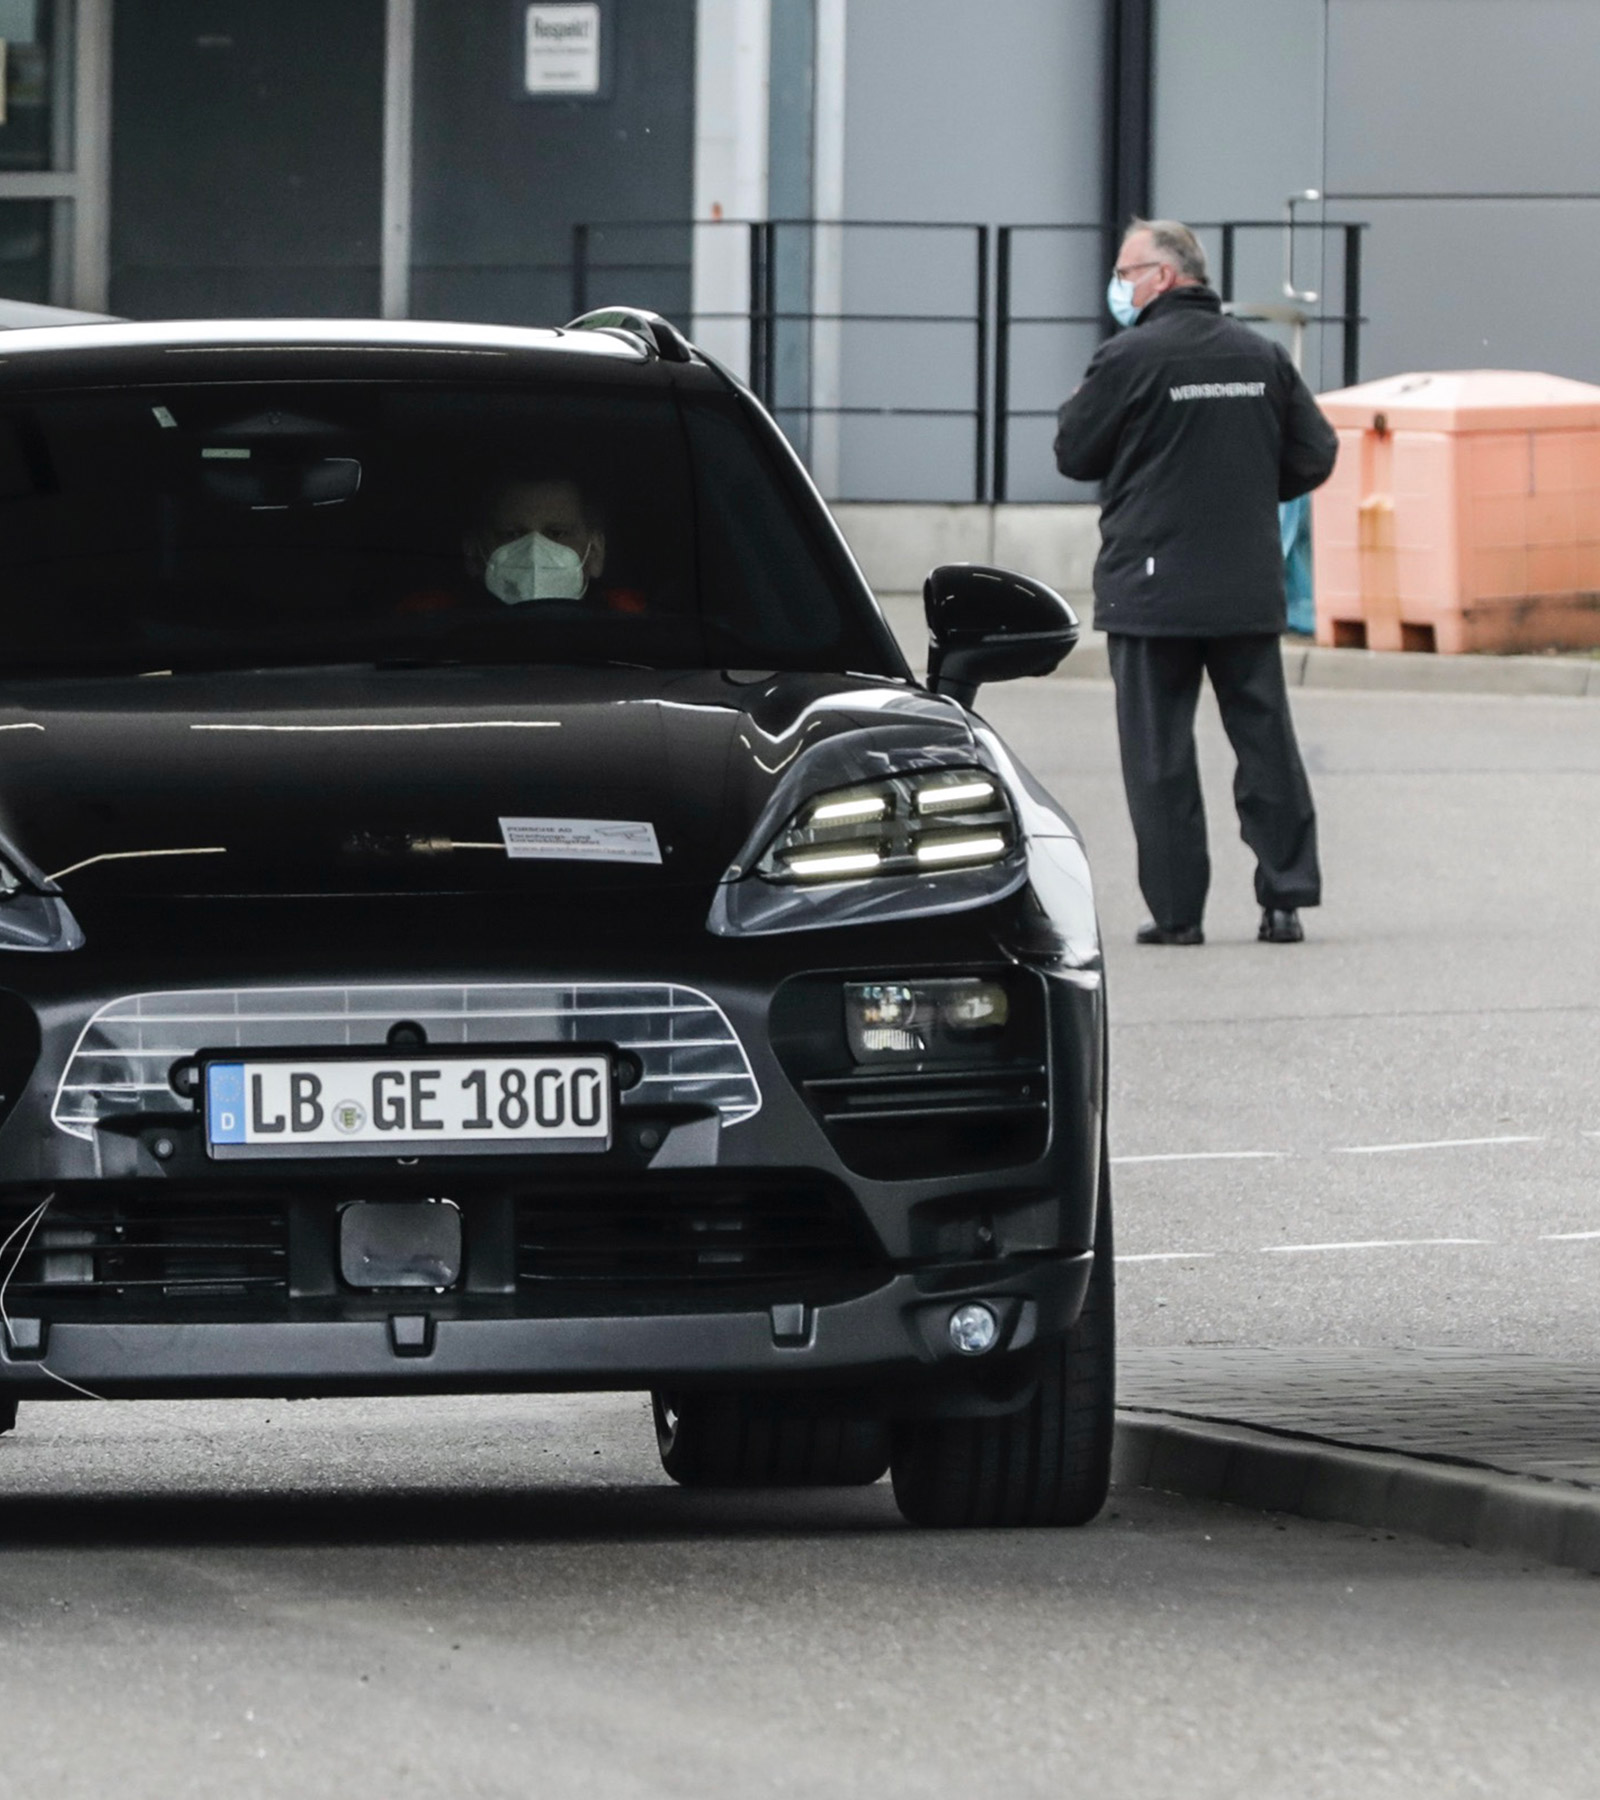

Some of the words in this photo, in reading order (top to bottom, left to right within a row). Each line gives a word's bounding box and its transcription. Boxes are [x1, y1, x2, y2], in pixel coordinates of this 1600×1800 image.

[1169, 382, 1266, 402] WERKSICHERHEIT
[252, 1072, 324, 1134] LB
[372, 1070, 444, 1131] GE
[461, 1068, 602, 1130] 1800
[221, 1112, 235, 1131] D
